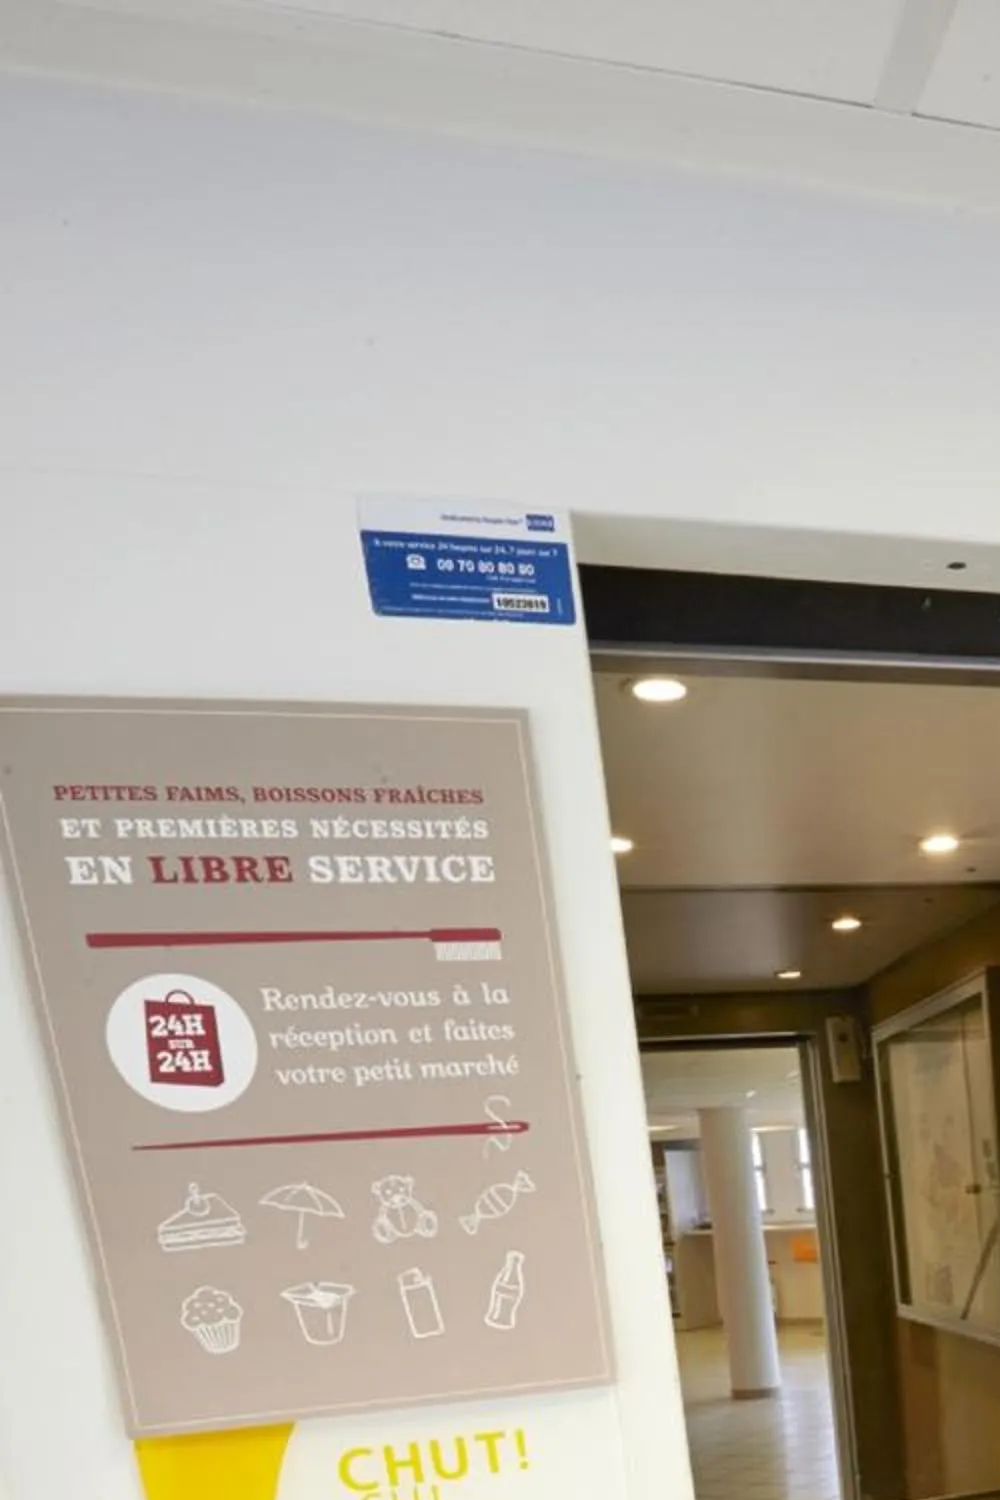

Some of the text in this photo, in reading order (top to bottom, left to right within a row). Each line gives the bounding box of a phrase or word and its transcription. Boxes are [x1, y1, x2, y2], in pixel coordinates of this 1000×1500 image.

[53, 784, 485, 804] PETITES FAIMS, BOISSONS FRAÎCHES
[60, 812, 490, 840] ET PREMIÈRES NÉCESSITÉS
[64, 855, 496, 885] EN LIBRE SERVICE
[259, 981, 511, 1012] Rendez-vous à la
[148, 1013, 206, 1037] 24H
[267, 1018, 516, 1052] réception et faites
[156, 1050, 214, 1074] 24H
[274, 1053, 521, 1087] votre petit marché
[337, 1427, 530, 1493] CHUT!
